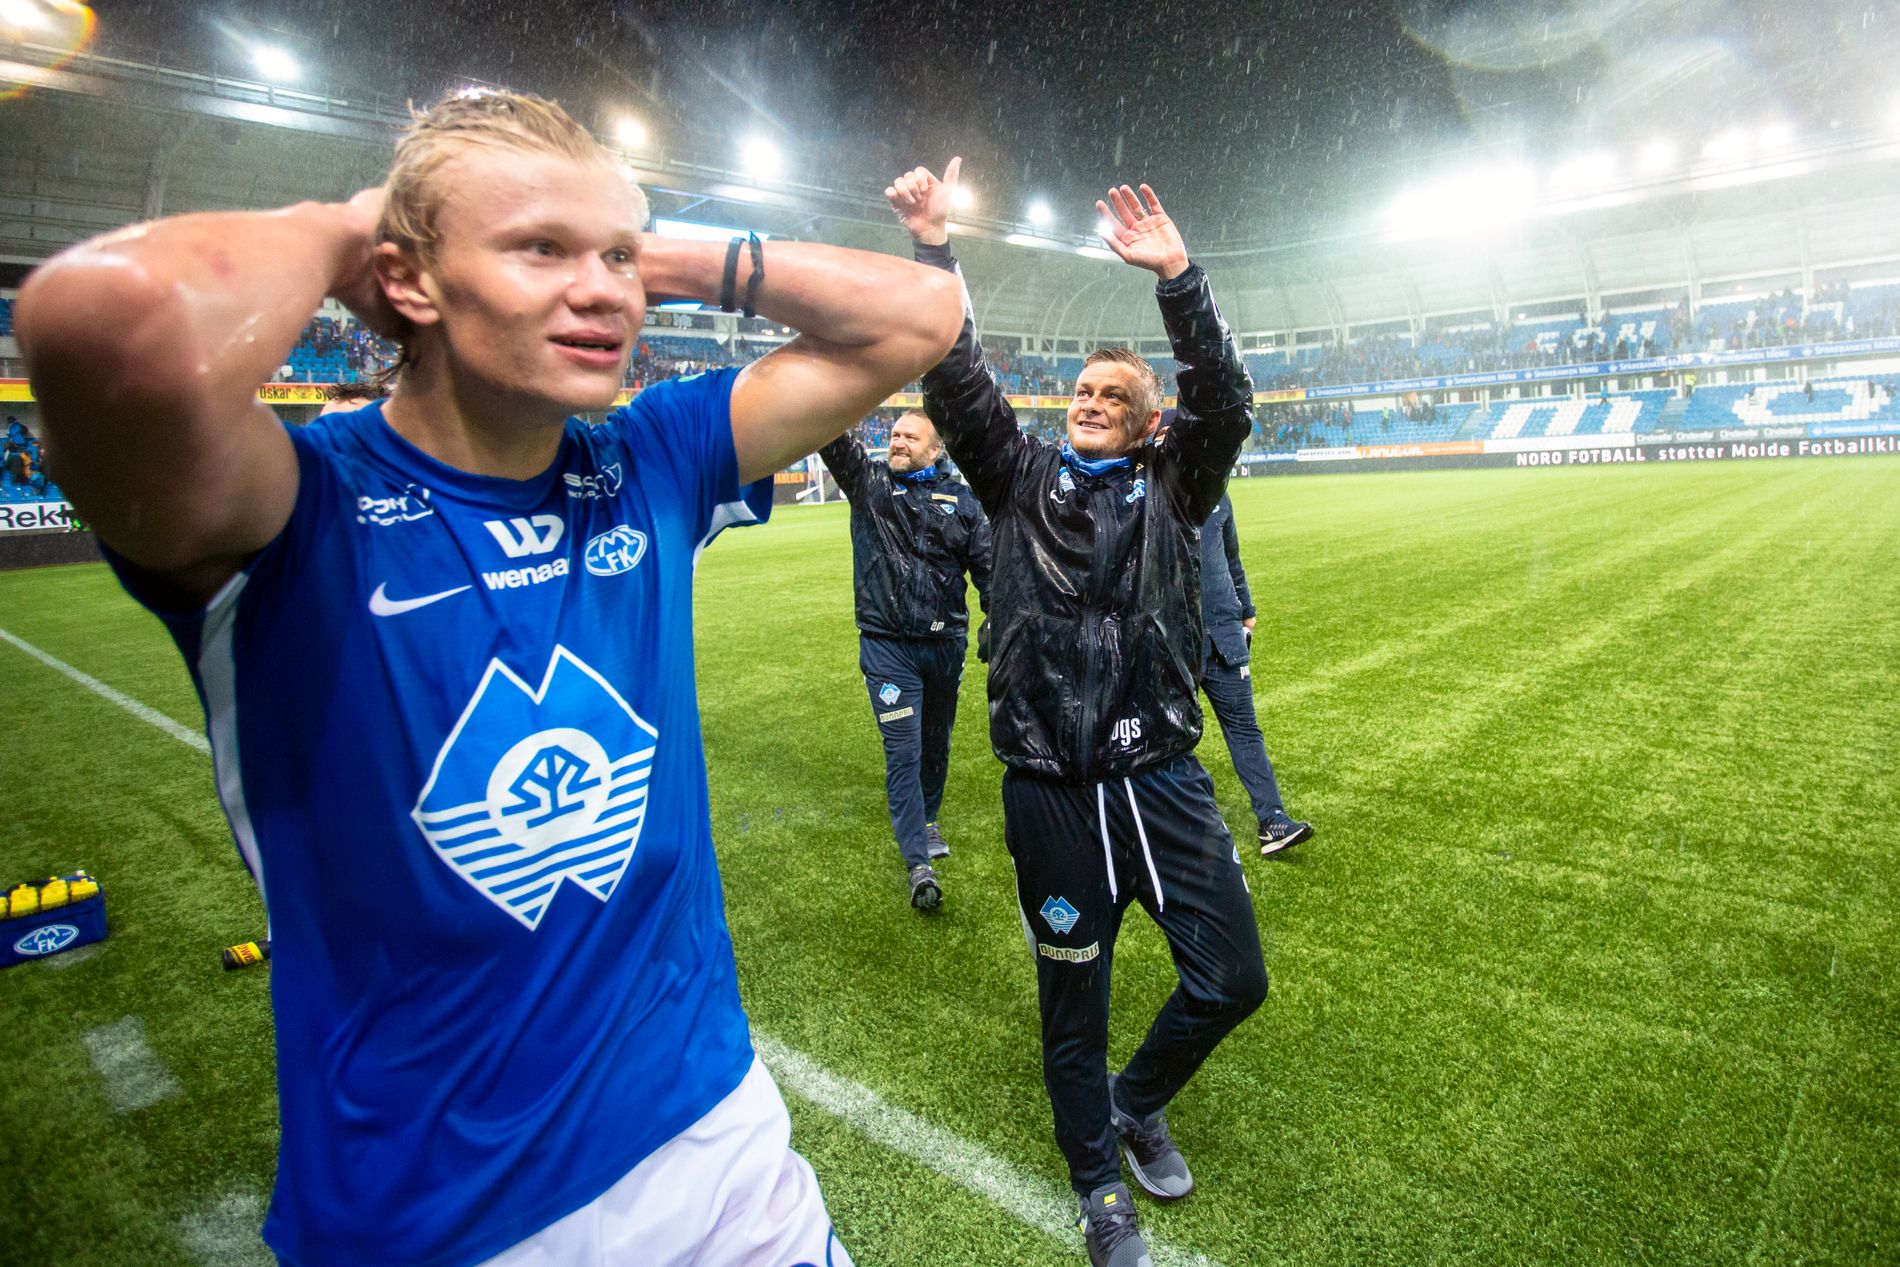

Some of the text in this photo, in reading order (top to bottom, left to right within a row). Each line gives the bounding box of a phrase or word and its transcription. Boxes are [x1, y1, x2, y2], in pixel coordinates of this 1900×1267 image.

[259, 386, 292, 400] Oskar
[1568, 448, 1646, 464] FOTBALL
[1659, 446, 1724, 461] støtter
[1731, 442, 1790, 458] Molde
[1798, 436, 1900, 456] Fotballkl
[481, 557, 570, 590] wenaa
